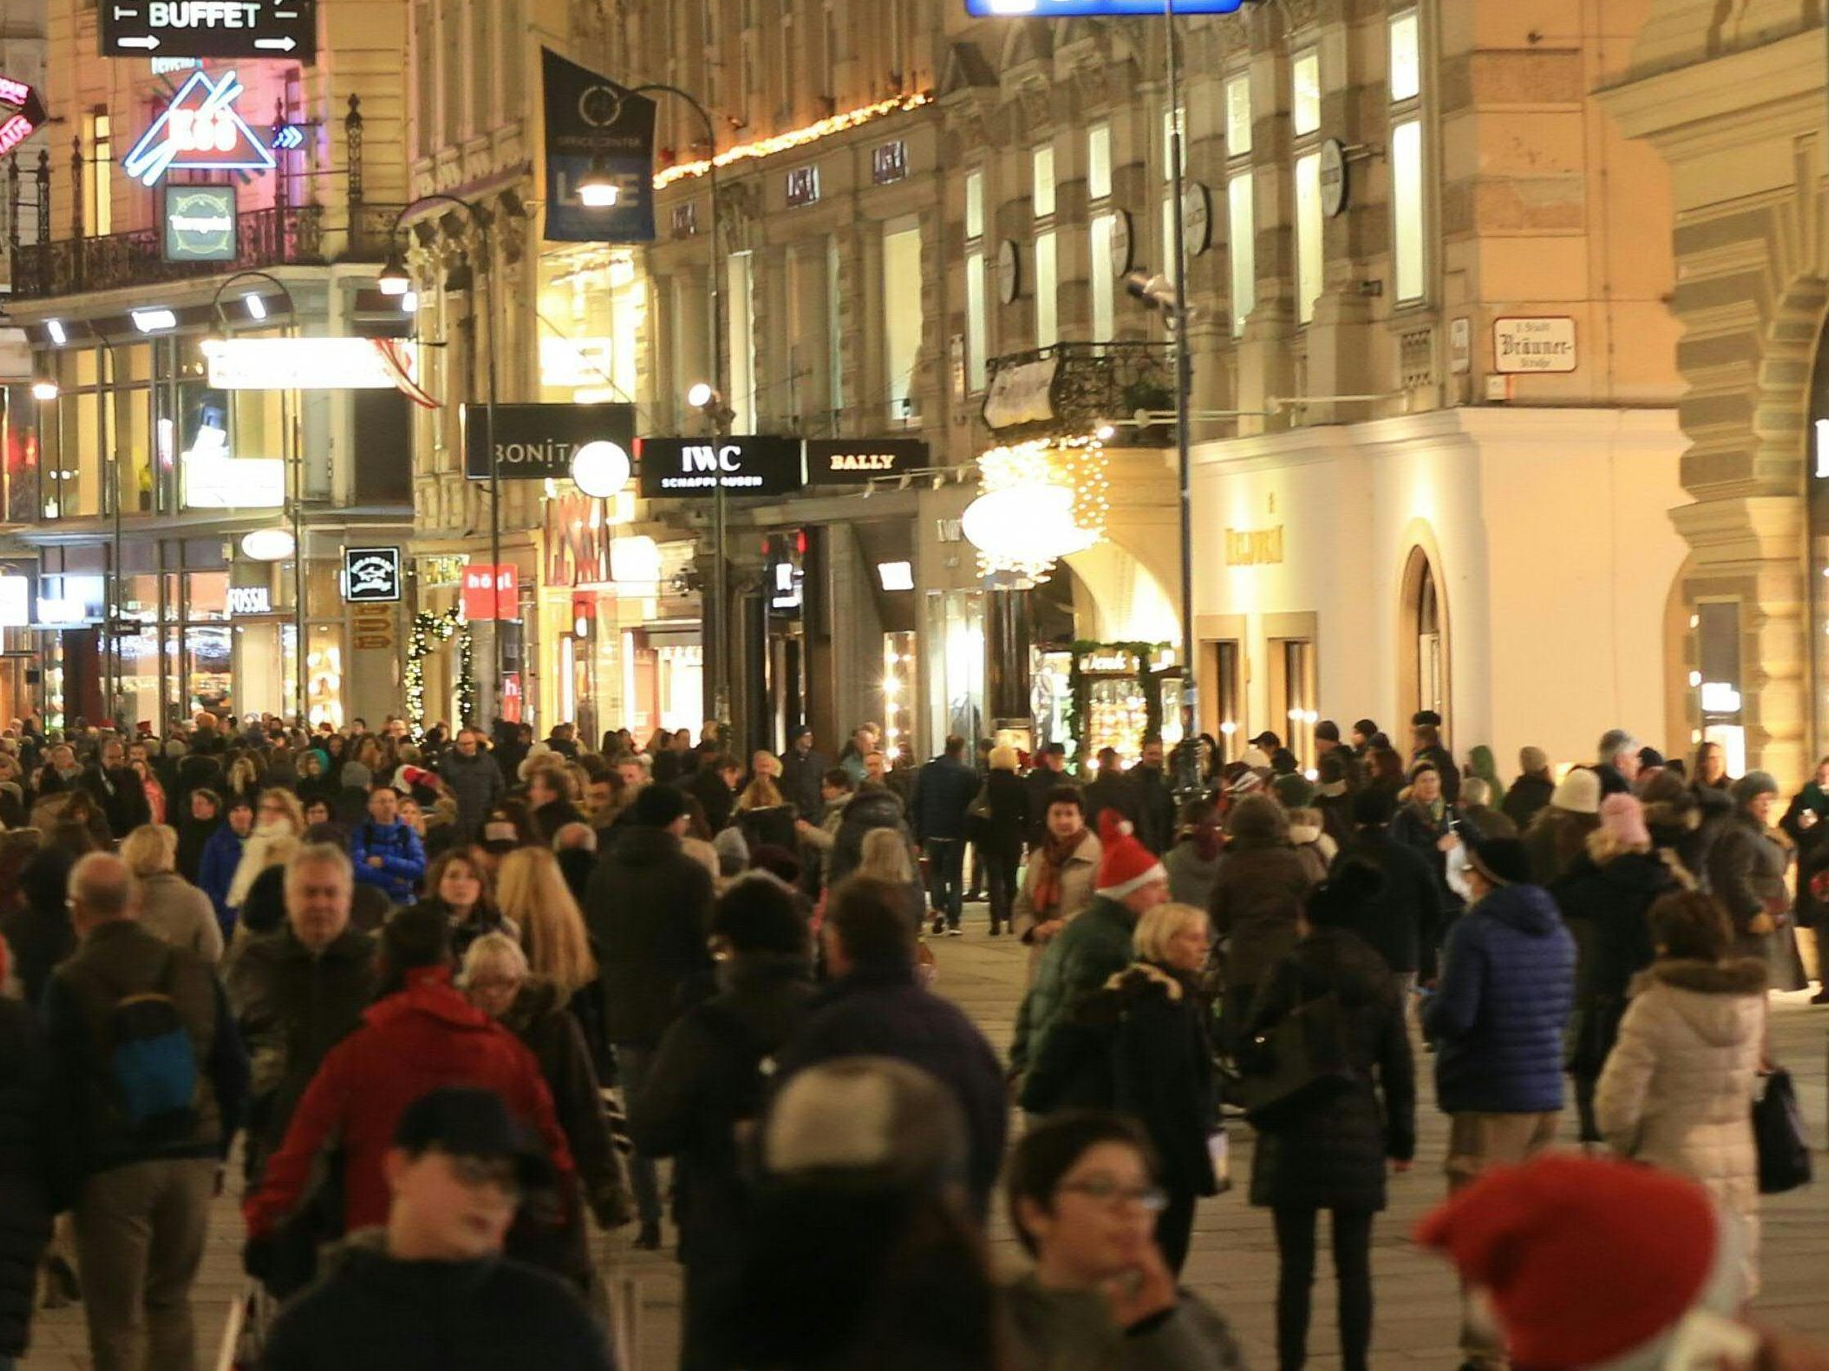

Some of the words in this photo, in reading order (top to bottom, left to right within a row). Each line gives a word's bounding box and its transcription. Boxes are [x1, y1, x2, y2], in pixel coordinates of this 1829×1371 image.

[148, 1, 261, 28] BUFFET
[681, 445, 742, 473] IWC
[830, 454, 895, 470] BALLY
[228, 588, 270, 613] FOSSIL
